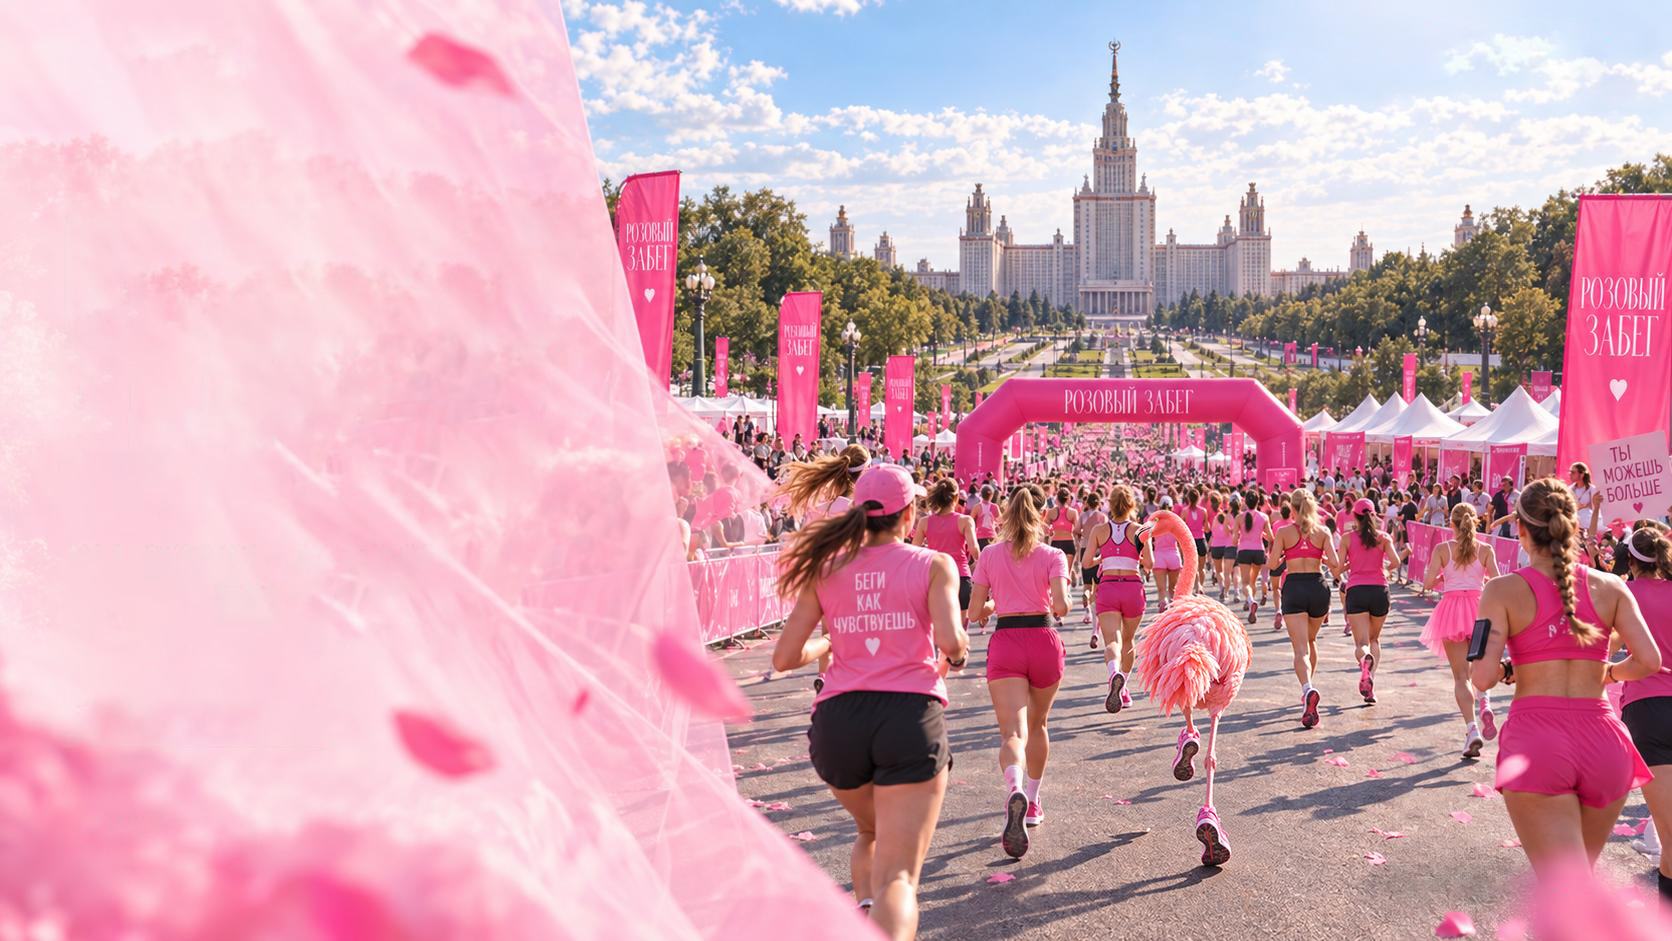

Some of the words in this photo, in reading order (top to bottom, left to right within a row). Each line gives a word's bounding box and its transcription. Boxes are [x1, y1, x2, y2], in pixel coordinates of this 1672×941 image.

[626, 218, 673, 243] РОЗОВЫЙ
[626, 244, 673, 271] ЗАБЕГ
[1581, 272, 1665, 310] РОЗОВЫЙ
[1584, 314, 1659, 357] ЗАБЕГ
[1064, 386, 1137, 414] РОЗОВЫЙ
[1144, 389, 1194, 414] ЗАБЕГ
[1610, 444, 1631, 463] ТЫ
[1603, 459, 1663, 484] МОЖЕШЬ
[1607, 479, 1662, 503] БОЛЬШЕ
[855, 572, 885, 591] БЕГИ
[857, 592, 881, 612] КАК
[834, 611, 916, 634] ЧУВСТВУЕШЬ
